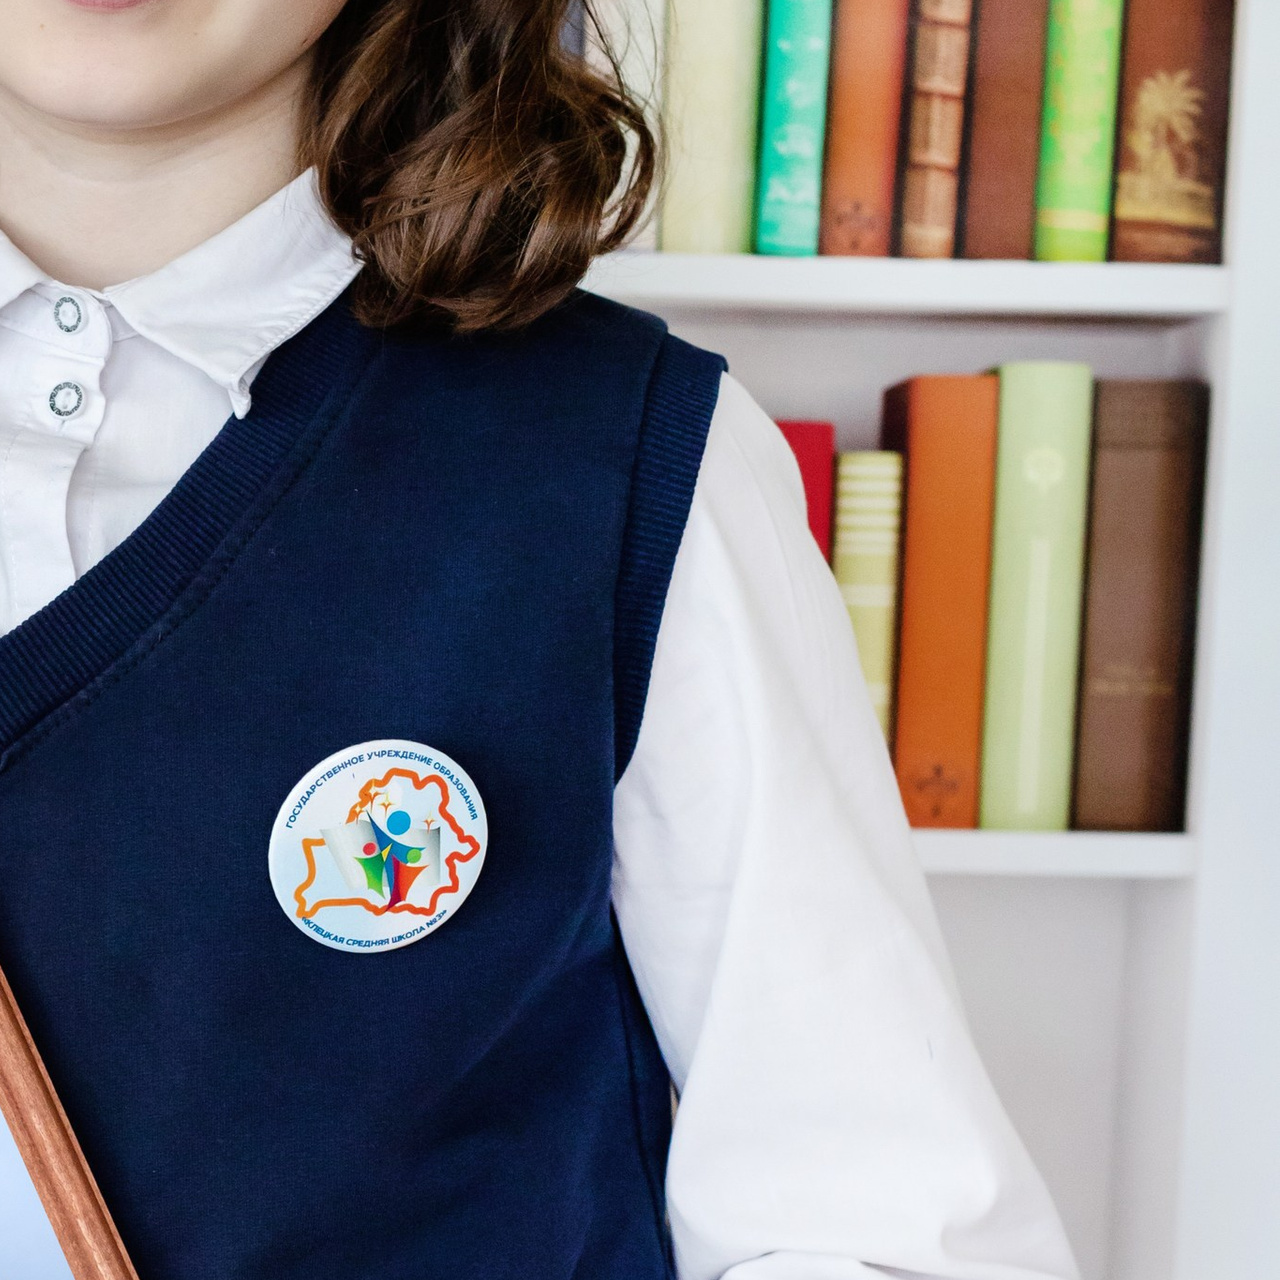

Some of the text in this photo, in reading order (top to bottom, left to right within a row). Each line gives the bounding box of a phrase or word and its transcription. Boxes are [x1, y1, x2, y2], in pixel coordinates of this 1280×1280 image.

[286, 749, 478, 829] ГОСУДАРСТВЕННОЕ УЧРЕЖДЕНИЕ ОБРАЗОВАНИЯ
[301, 909, 448, 948] «КЛЕЦКАЯ СРЕДНЯЯ ШКОЛА №3»
